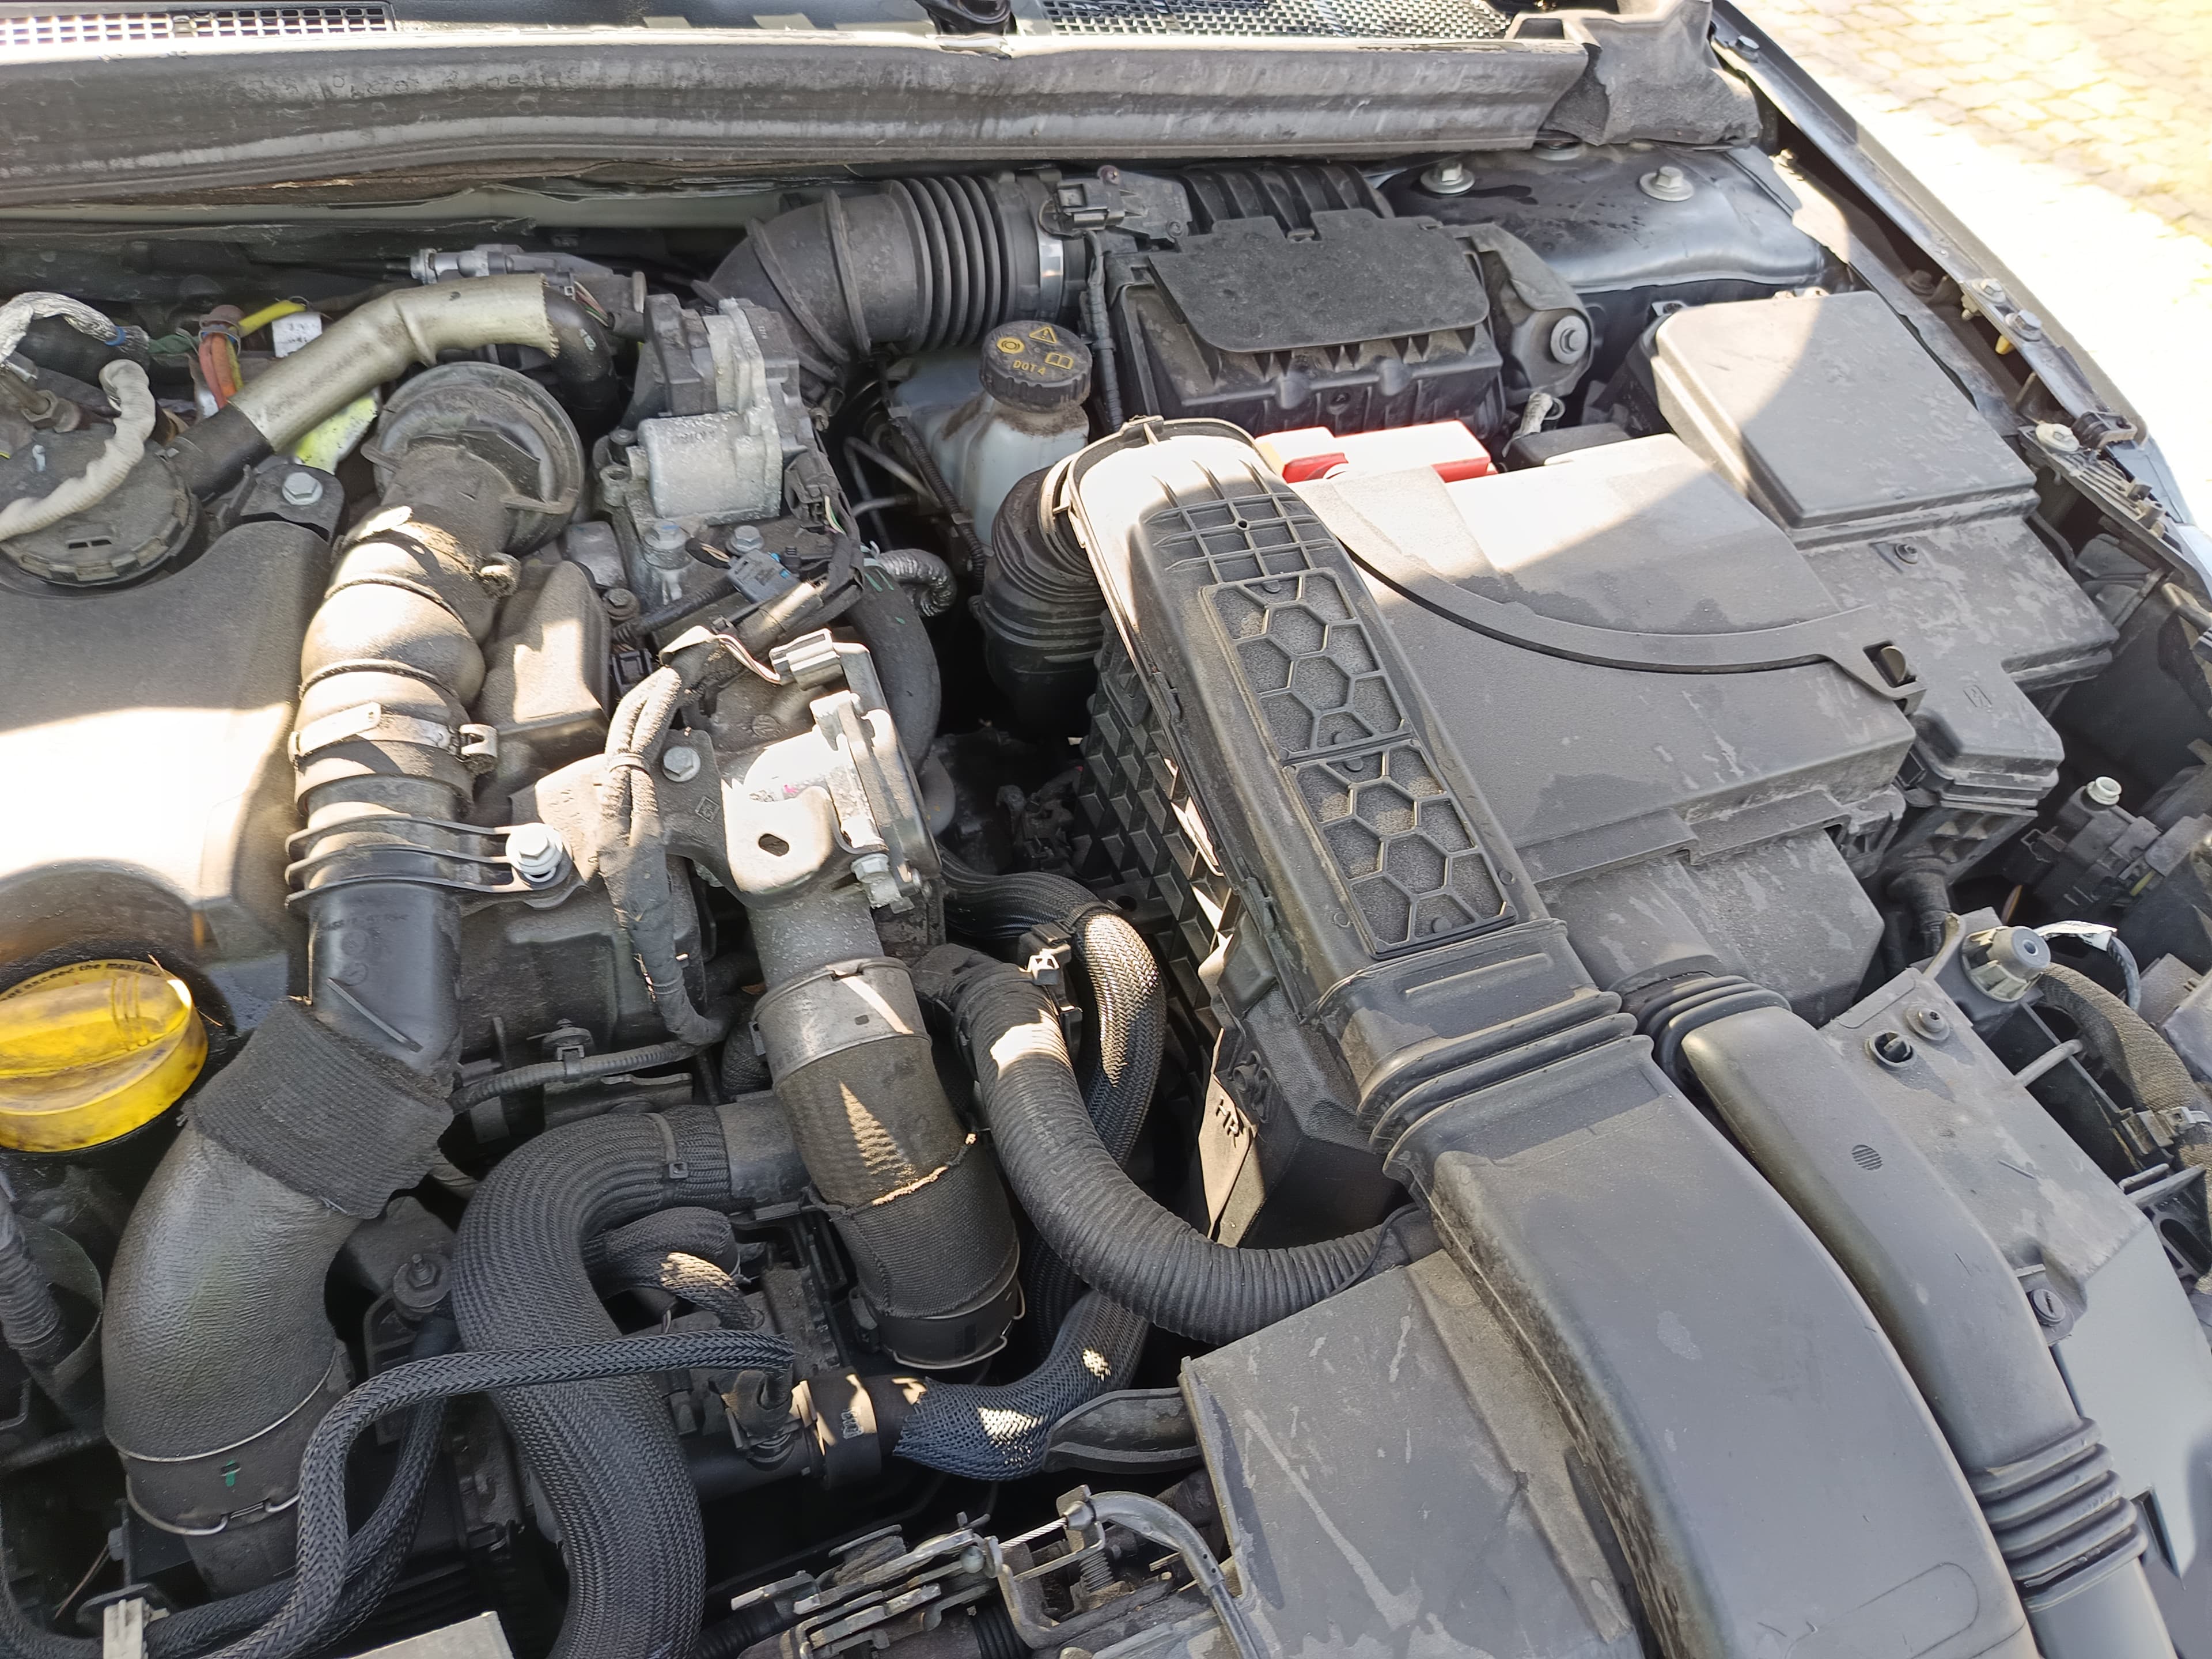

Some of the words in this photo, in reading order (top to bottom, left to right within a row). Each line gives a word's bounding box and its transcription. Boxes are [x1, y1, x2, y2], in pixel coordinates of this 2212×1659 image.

[1013, 360, 1037, 373] DOT
[1037, 366, 1047, 376] 4
[78, 963, 101, 971] the
